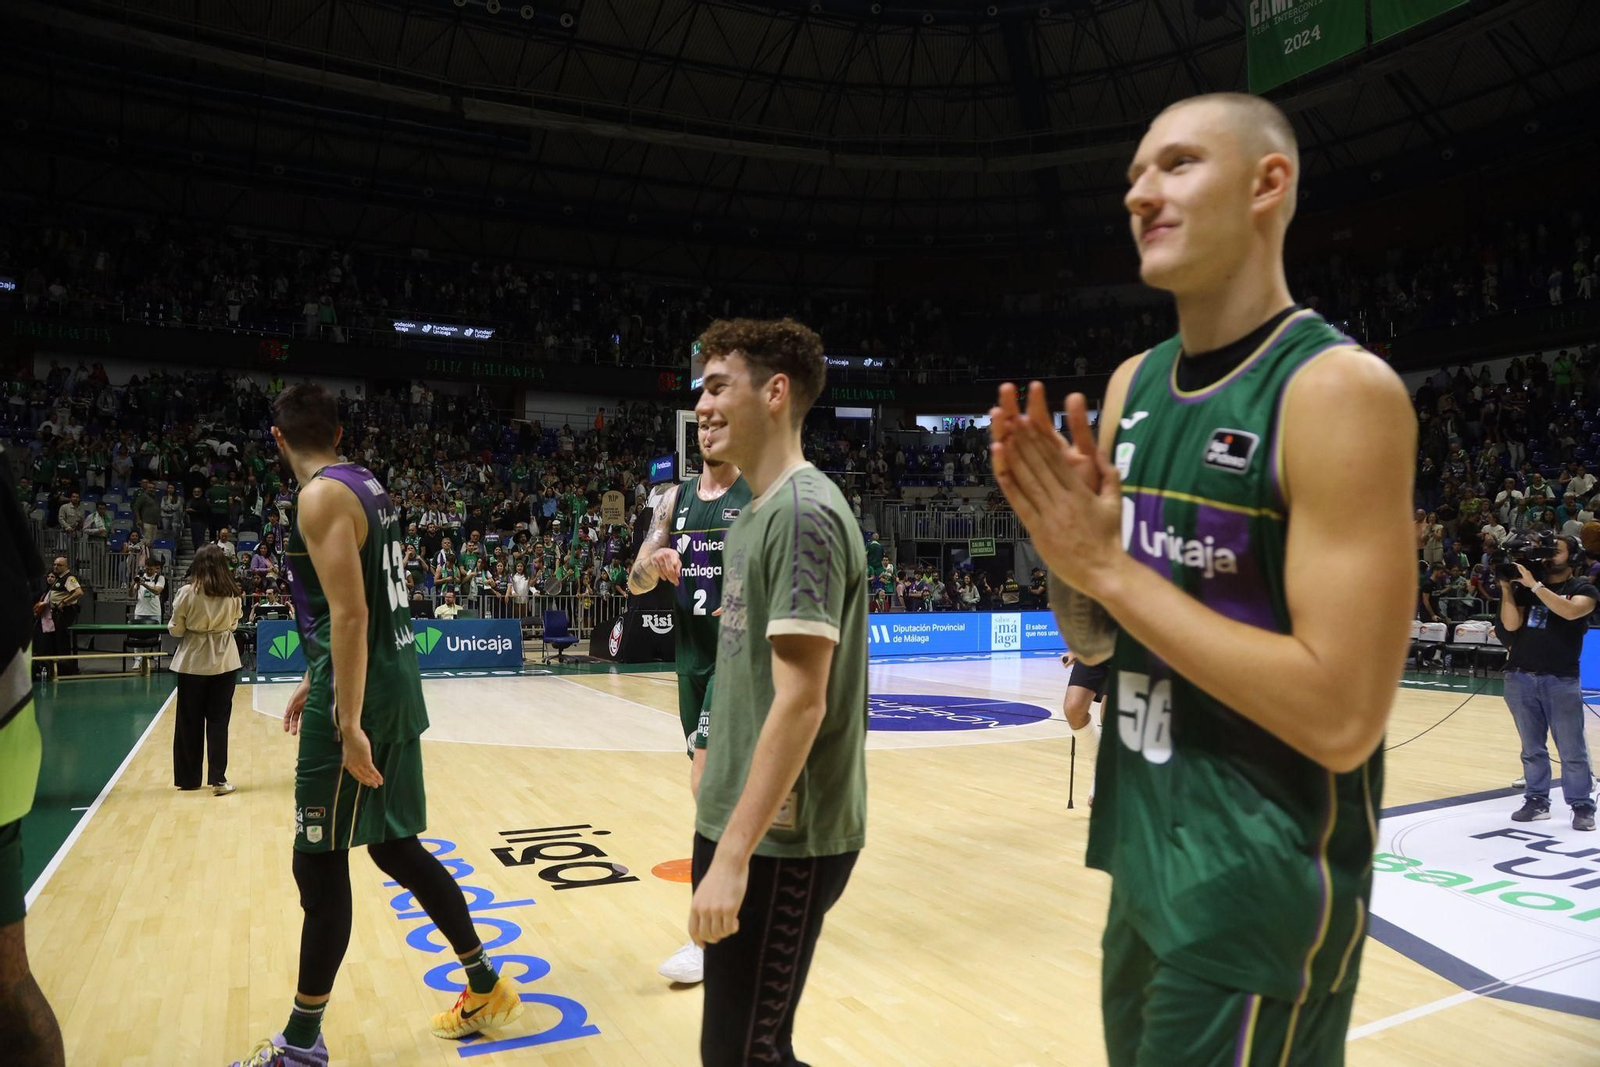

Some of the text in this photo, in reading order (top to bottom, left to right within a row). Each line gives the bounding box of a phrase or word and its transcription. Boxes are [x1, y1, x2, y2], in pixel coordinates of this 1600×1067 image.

[1250, 0, 1304, 27] CAM
[1293, 12, 1309, 24] CUP
[1252, 22, 1270, 37] FIBA
[1284, 24, 1321, 55] 2024
[828, 359, 849, 367] Unicaja
[608, 495, 619, 503] RIP
[1139, 519, 1239, 579] Unicaja
[682, 562, 722, 579] málaga
[692, 588, 707, 616] 2
[642, 614, 674, 634] Risi
[893, 622, 965, 633] Diputación Provincial
[1032, 623, 1048, 631] sabor
[446, 636, 512, 655] Unicaja
[893, 634, 930, 644] de Málaga
[1117, 669, 1172, 765] 56
[1468, 827, 1600, 864] FU
[490, 824, 640, 891] liga
[1493, 856, 1600, 891] U
[378, 838, 602, 1059] desa
